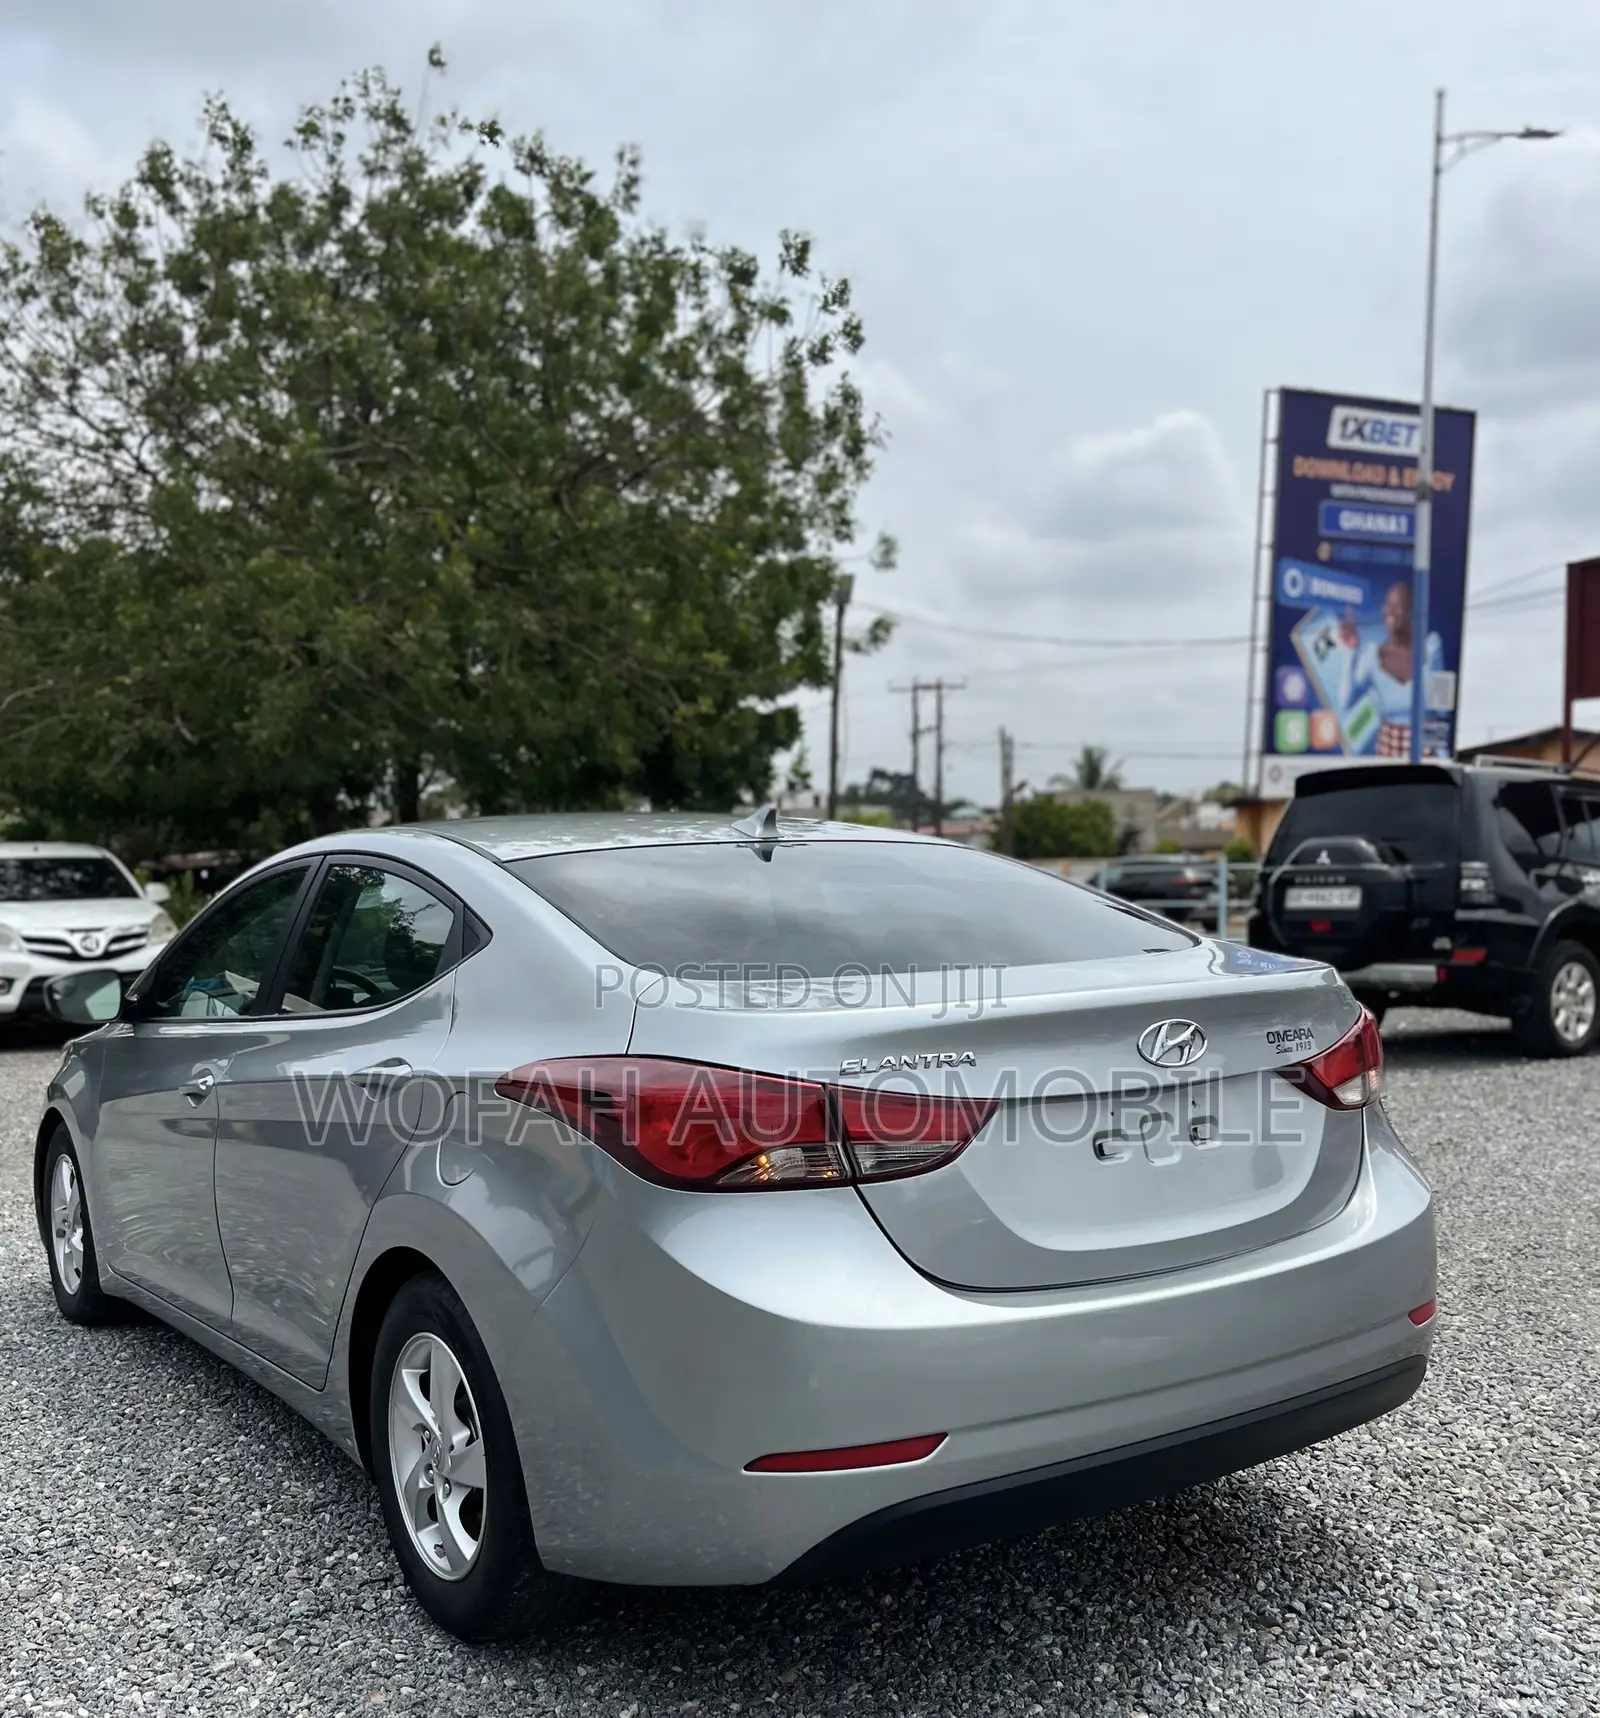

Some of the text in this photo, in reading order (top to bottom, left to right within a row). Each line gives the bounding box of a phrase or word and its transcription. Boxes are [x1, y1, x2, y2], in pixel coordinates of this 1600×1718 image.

[1340, 416, 1419, 448] 1XBET
[1266, 1027, 1315, 1044] O'MEARA
[1295, 1040, 1312, 1052] 1913
[839, 1051, 977, 1076] ELANTRA
